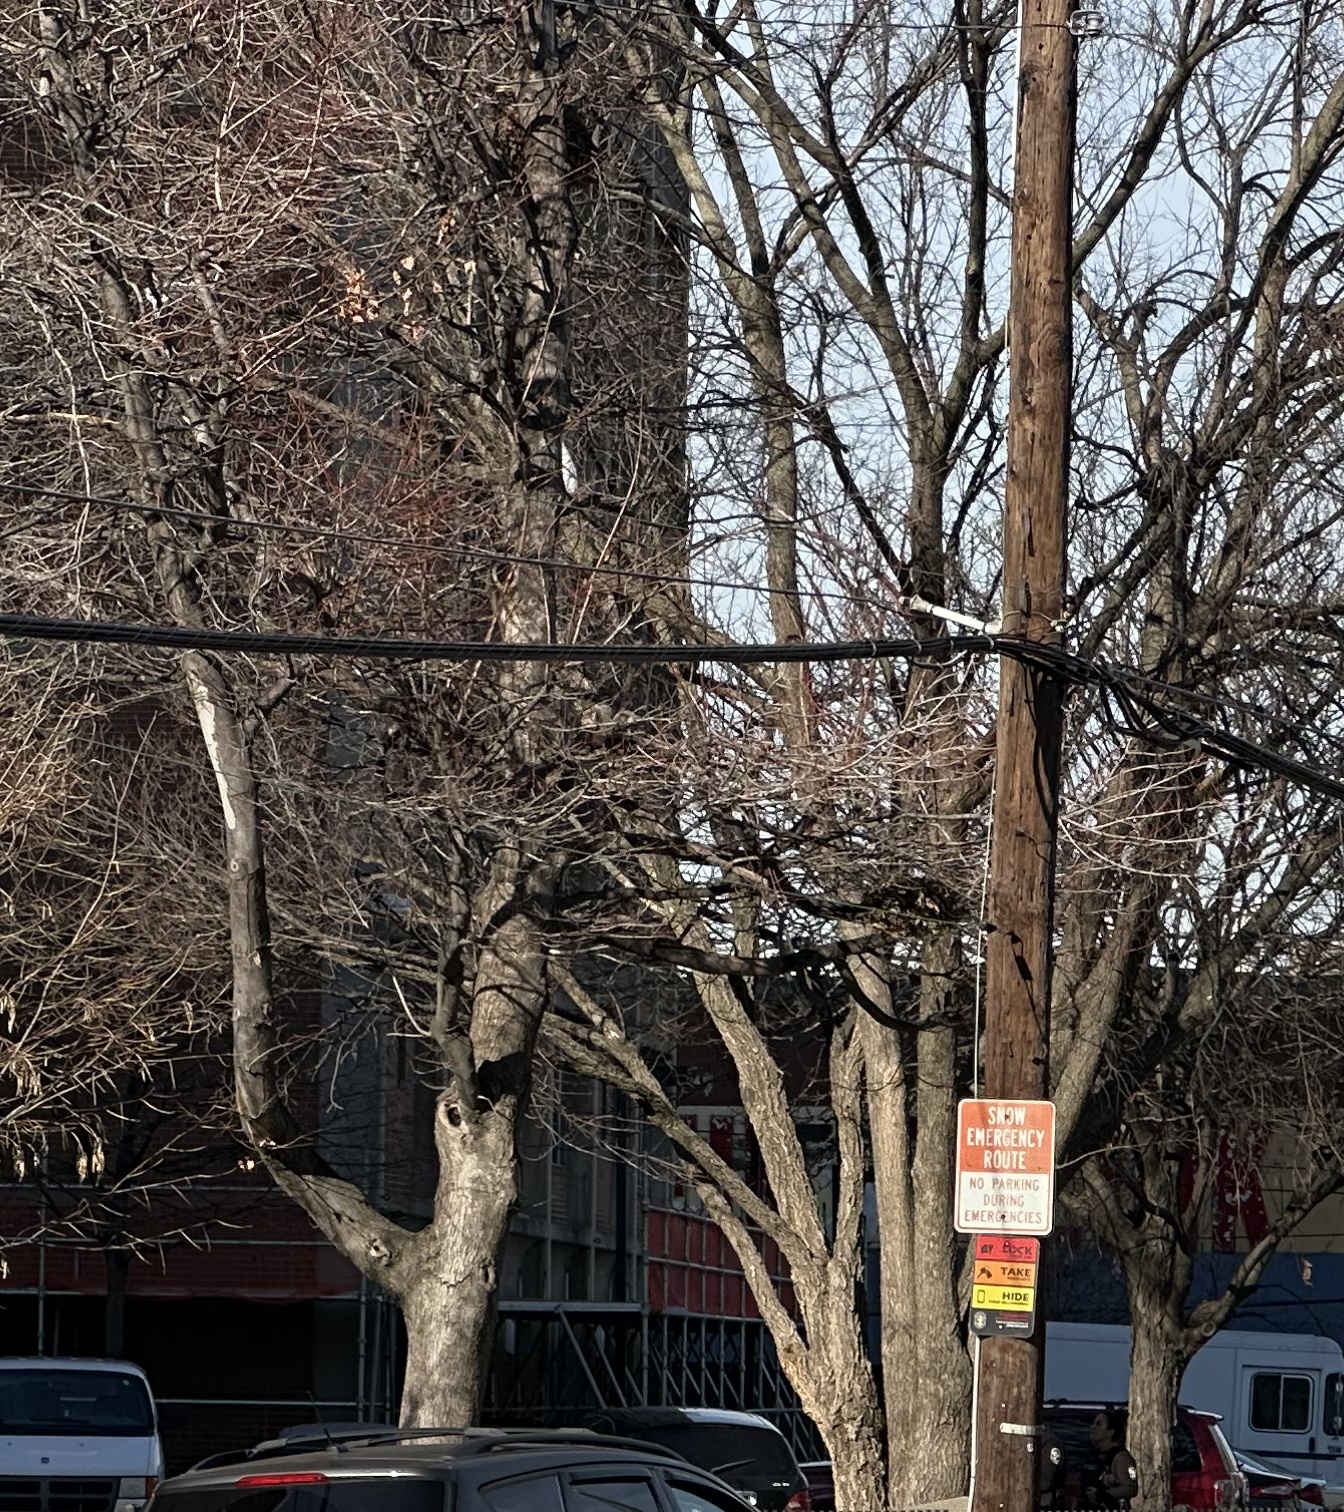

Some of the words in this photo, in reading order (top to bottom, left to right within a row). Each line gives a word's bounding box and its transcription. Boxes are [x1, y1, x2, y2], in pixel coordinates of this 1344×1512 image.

[987, 1106, 1026, 1126] SNOW
[966, 1128, 1045, 1148] EMERGENCY
[983, 1150, 1026, 1170] ROUTE
[969, 1177, 984, 1190] NO
[992, 1178, 1040, 1191] PARKING
[984, 1194, 1024, 1207] DURING
[964, 1210, 1042, 1224] EMERGENCIES
[1001, 1266, 1032, 1277] TAKE
[1002, 1292, 1030, 1302] HIDE
